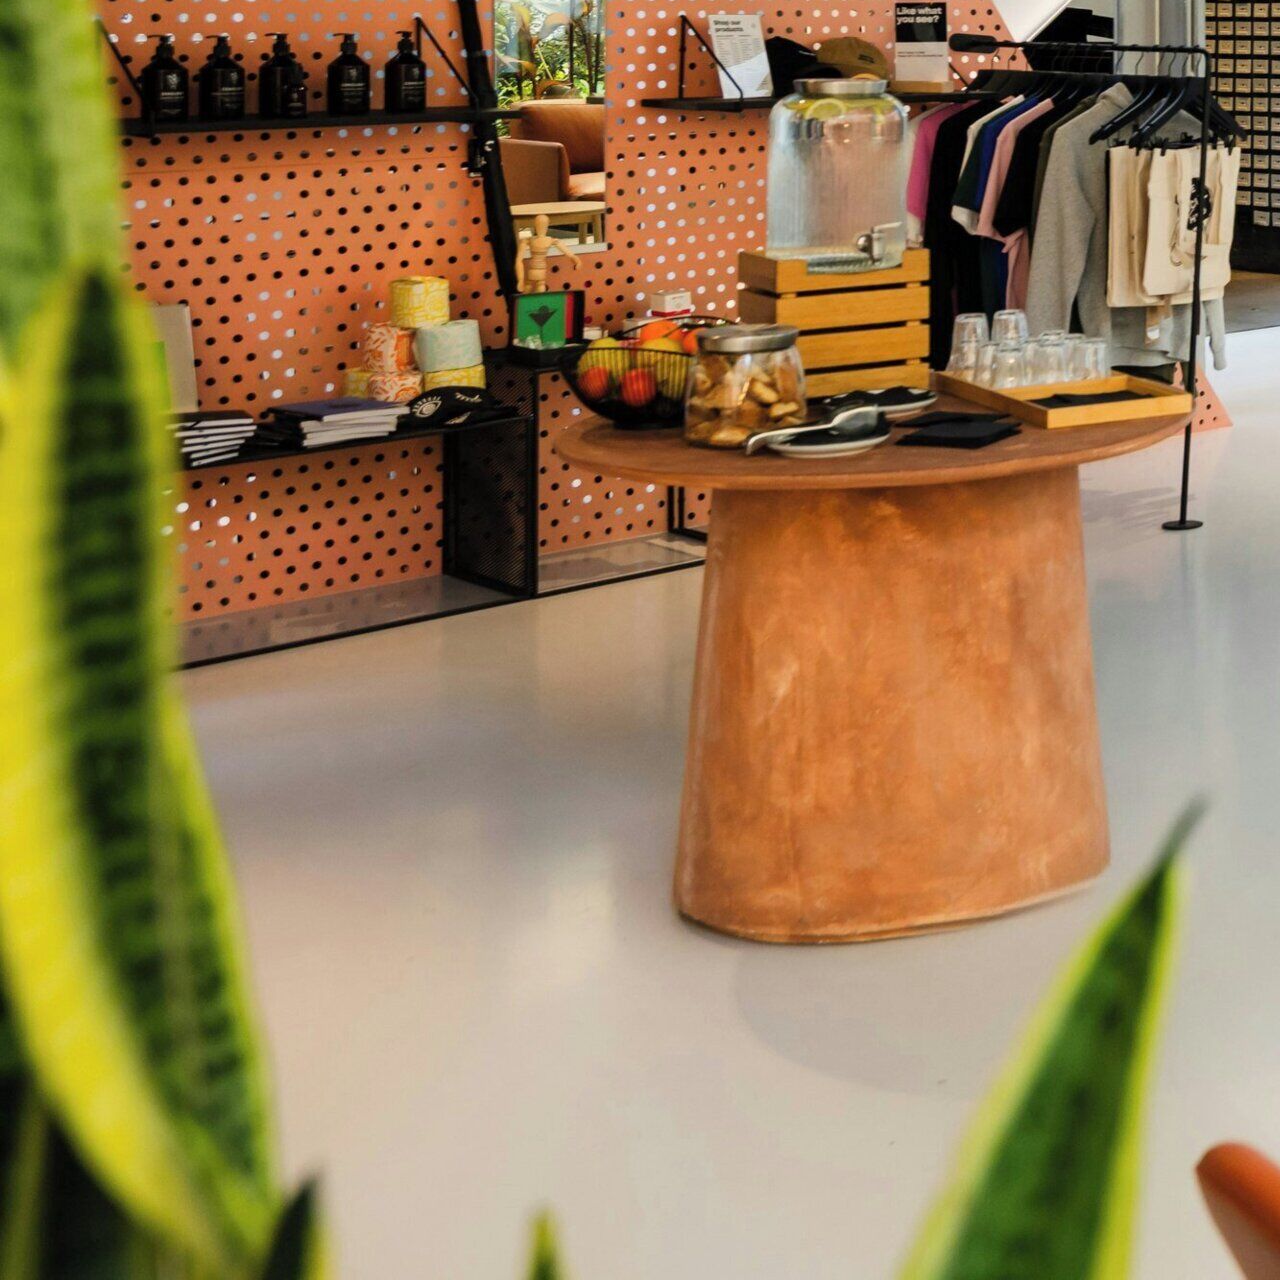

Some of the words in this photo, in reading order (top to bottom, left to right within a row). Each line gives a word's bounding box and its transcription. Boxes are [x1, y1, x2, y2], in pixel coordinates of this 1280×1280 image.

[896, 6, 917, 15] Like
[918, 6, 942, 15] what
[896, 16, 914, 25] you
[915, 15, 940, 24] see?
